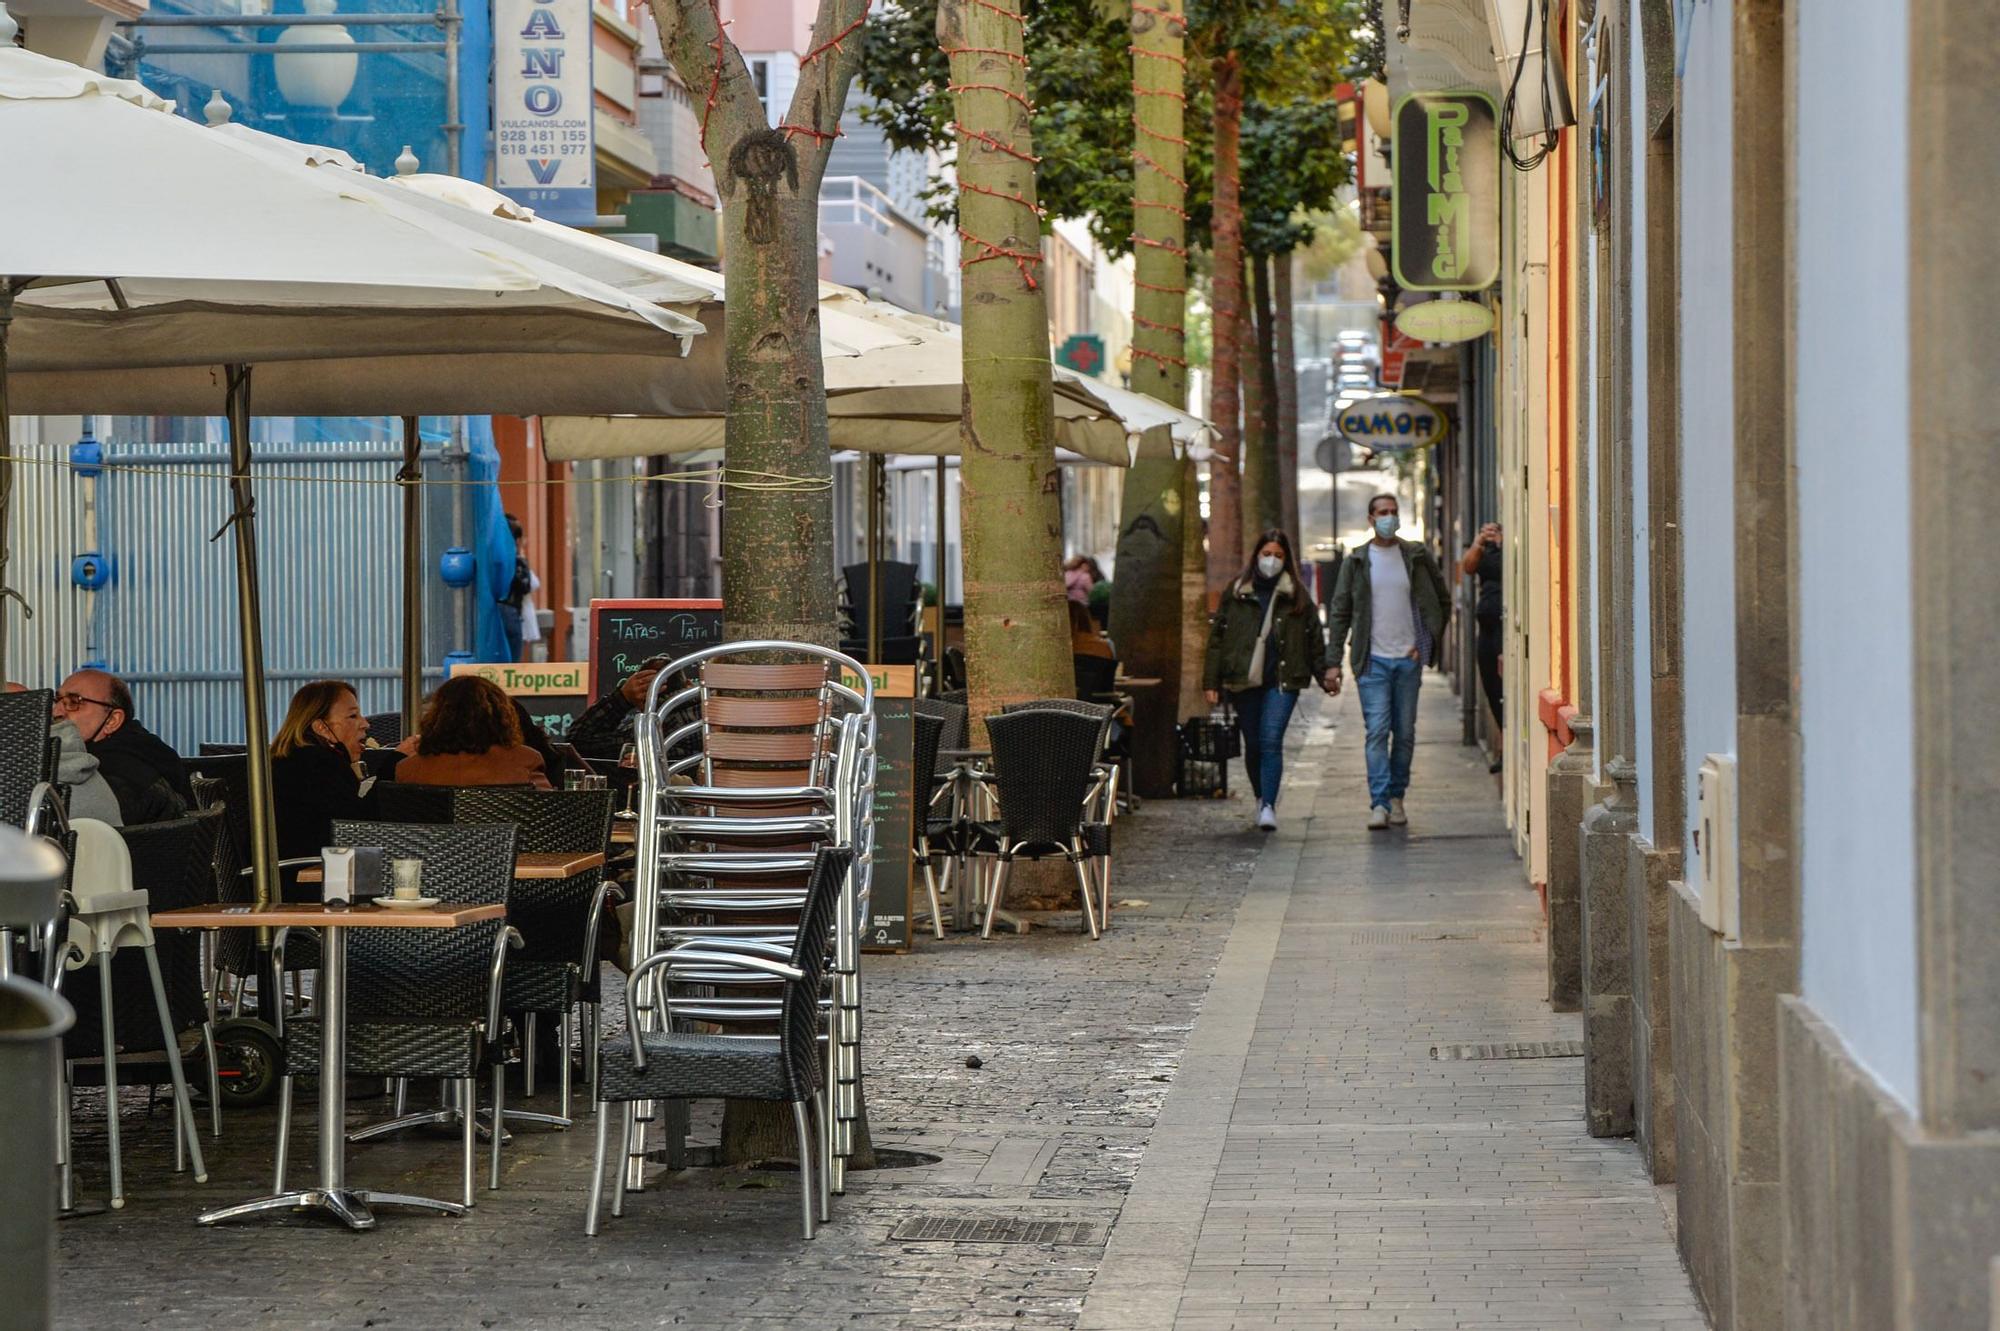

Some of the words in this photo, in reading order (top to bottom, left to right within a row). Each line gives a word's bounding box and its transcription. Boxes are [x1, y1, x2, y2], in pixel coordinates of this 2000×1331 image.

[520, 0, 565, 117] ANO
[501, 120, 586, 128] VULCANOSL.COM
[501, 130, 526, 141] 928
[531, 130, 554, 141] 181
[562, 130, 586, 141] 155
[501, 144, 526, 155] 618
[530, 144, 554, 155] 451
[560, 144, 586, 155] 977
[504, 669, 579, 692] Tropical
